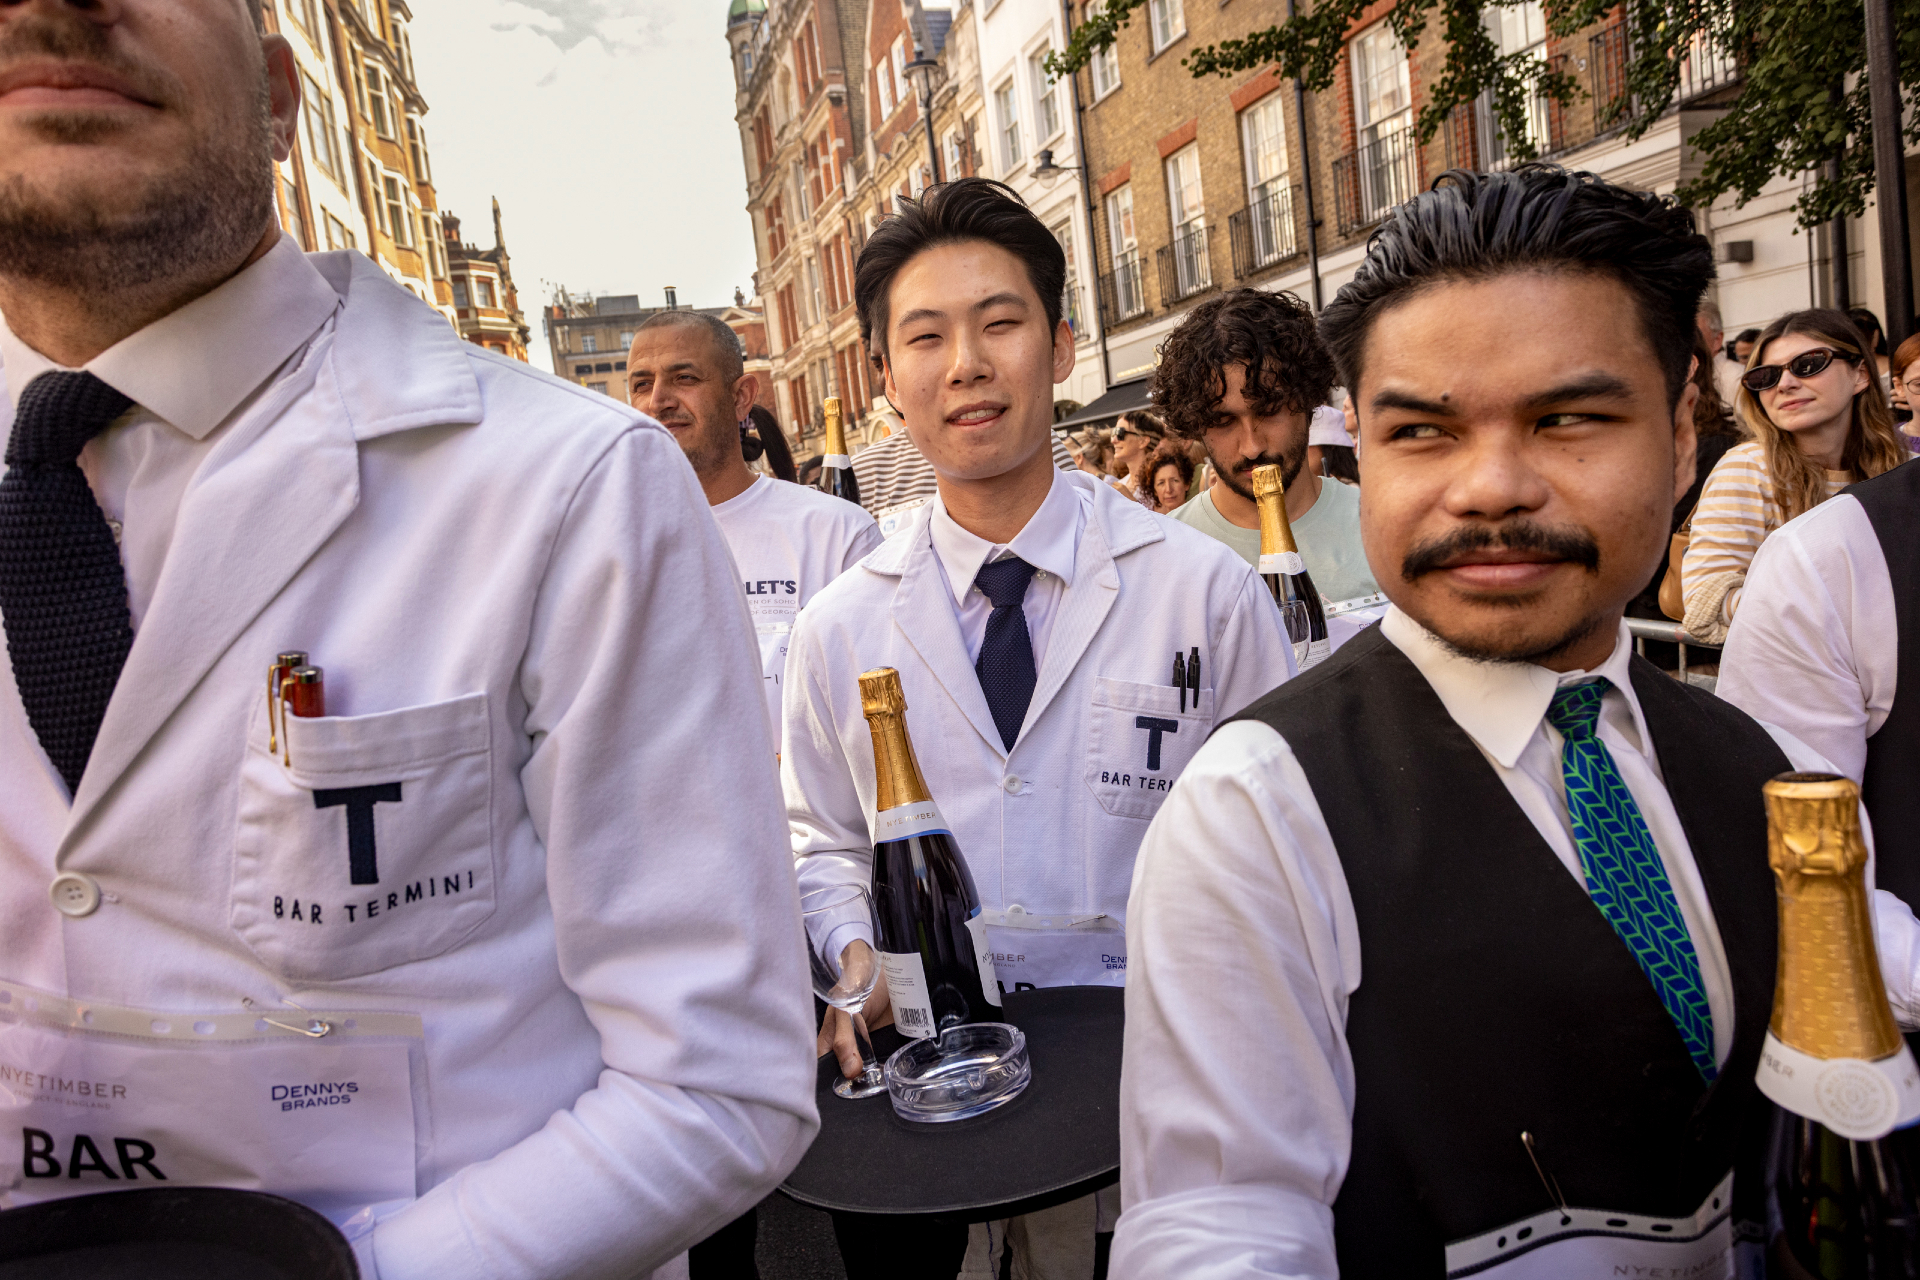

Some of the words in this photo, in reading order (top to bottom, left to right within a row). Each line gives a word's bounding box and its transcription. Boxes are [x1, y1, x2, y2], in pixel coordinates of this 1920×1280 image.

[743, 580, 797, 595] LET'S
[1135, 715, 1179, 771] T
[1101, 771, 1132, 788] BAR
[886, 811, 937, 828] NYETIMBER
[312, 781, 404, 886] T
[273, 896, 323, 925] BAR
[344, 870, 474, 923] TERMINI
[0, 1065, 127, 1100] NYETIMBER
[272, 1082, 359, 1101] DENNYS
[66, 1099, 111, 1110] ENGLAND
[281, 1094, 351, 1112] BRANDS
[23, 1126, 167, 1180] BAR
